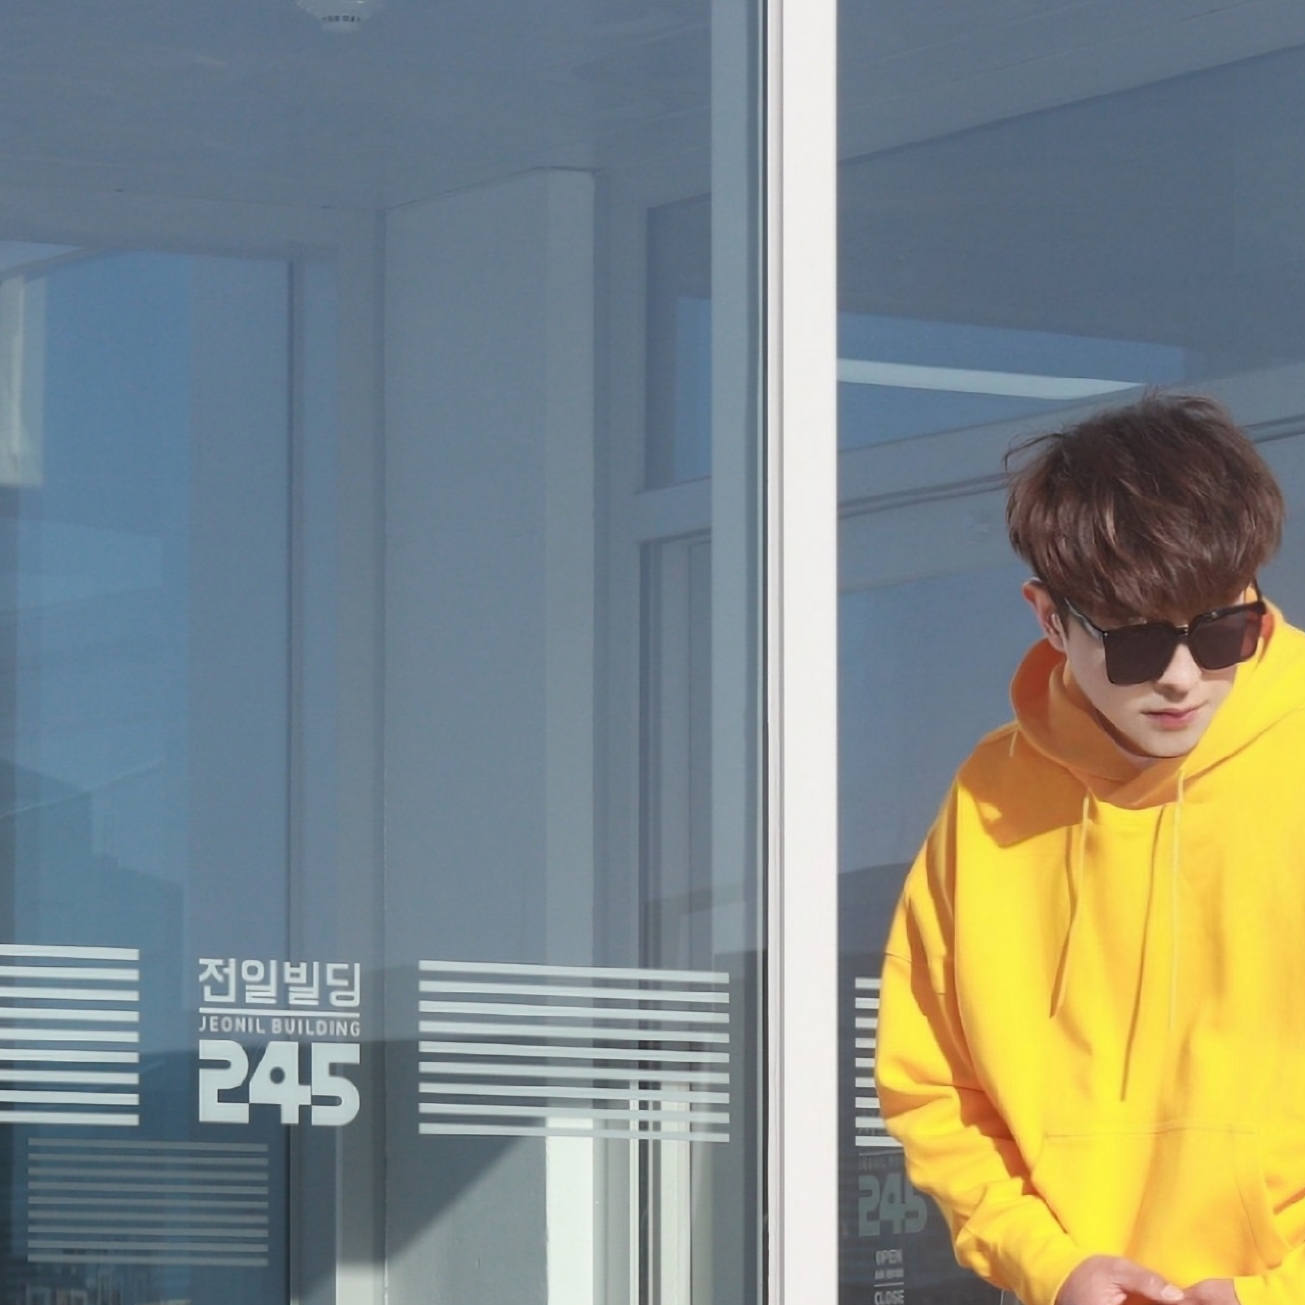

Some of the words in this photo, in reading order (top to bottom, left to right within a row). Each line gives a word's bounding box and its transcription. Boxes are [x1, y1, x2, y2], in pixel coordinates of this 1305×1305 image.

[198, 957, 361, 1008] 전일빌딩
[198, 1015, 266, 1035] JEONIL
[271, 1017, 361, 1038] BUILDING
[198, 1038, 361, 1127] 245
[875, 1248, 903, 1266] OPEN
